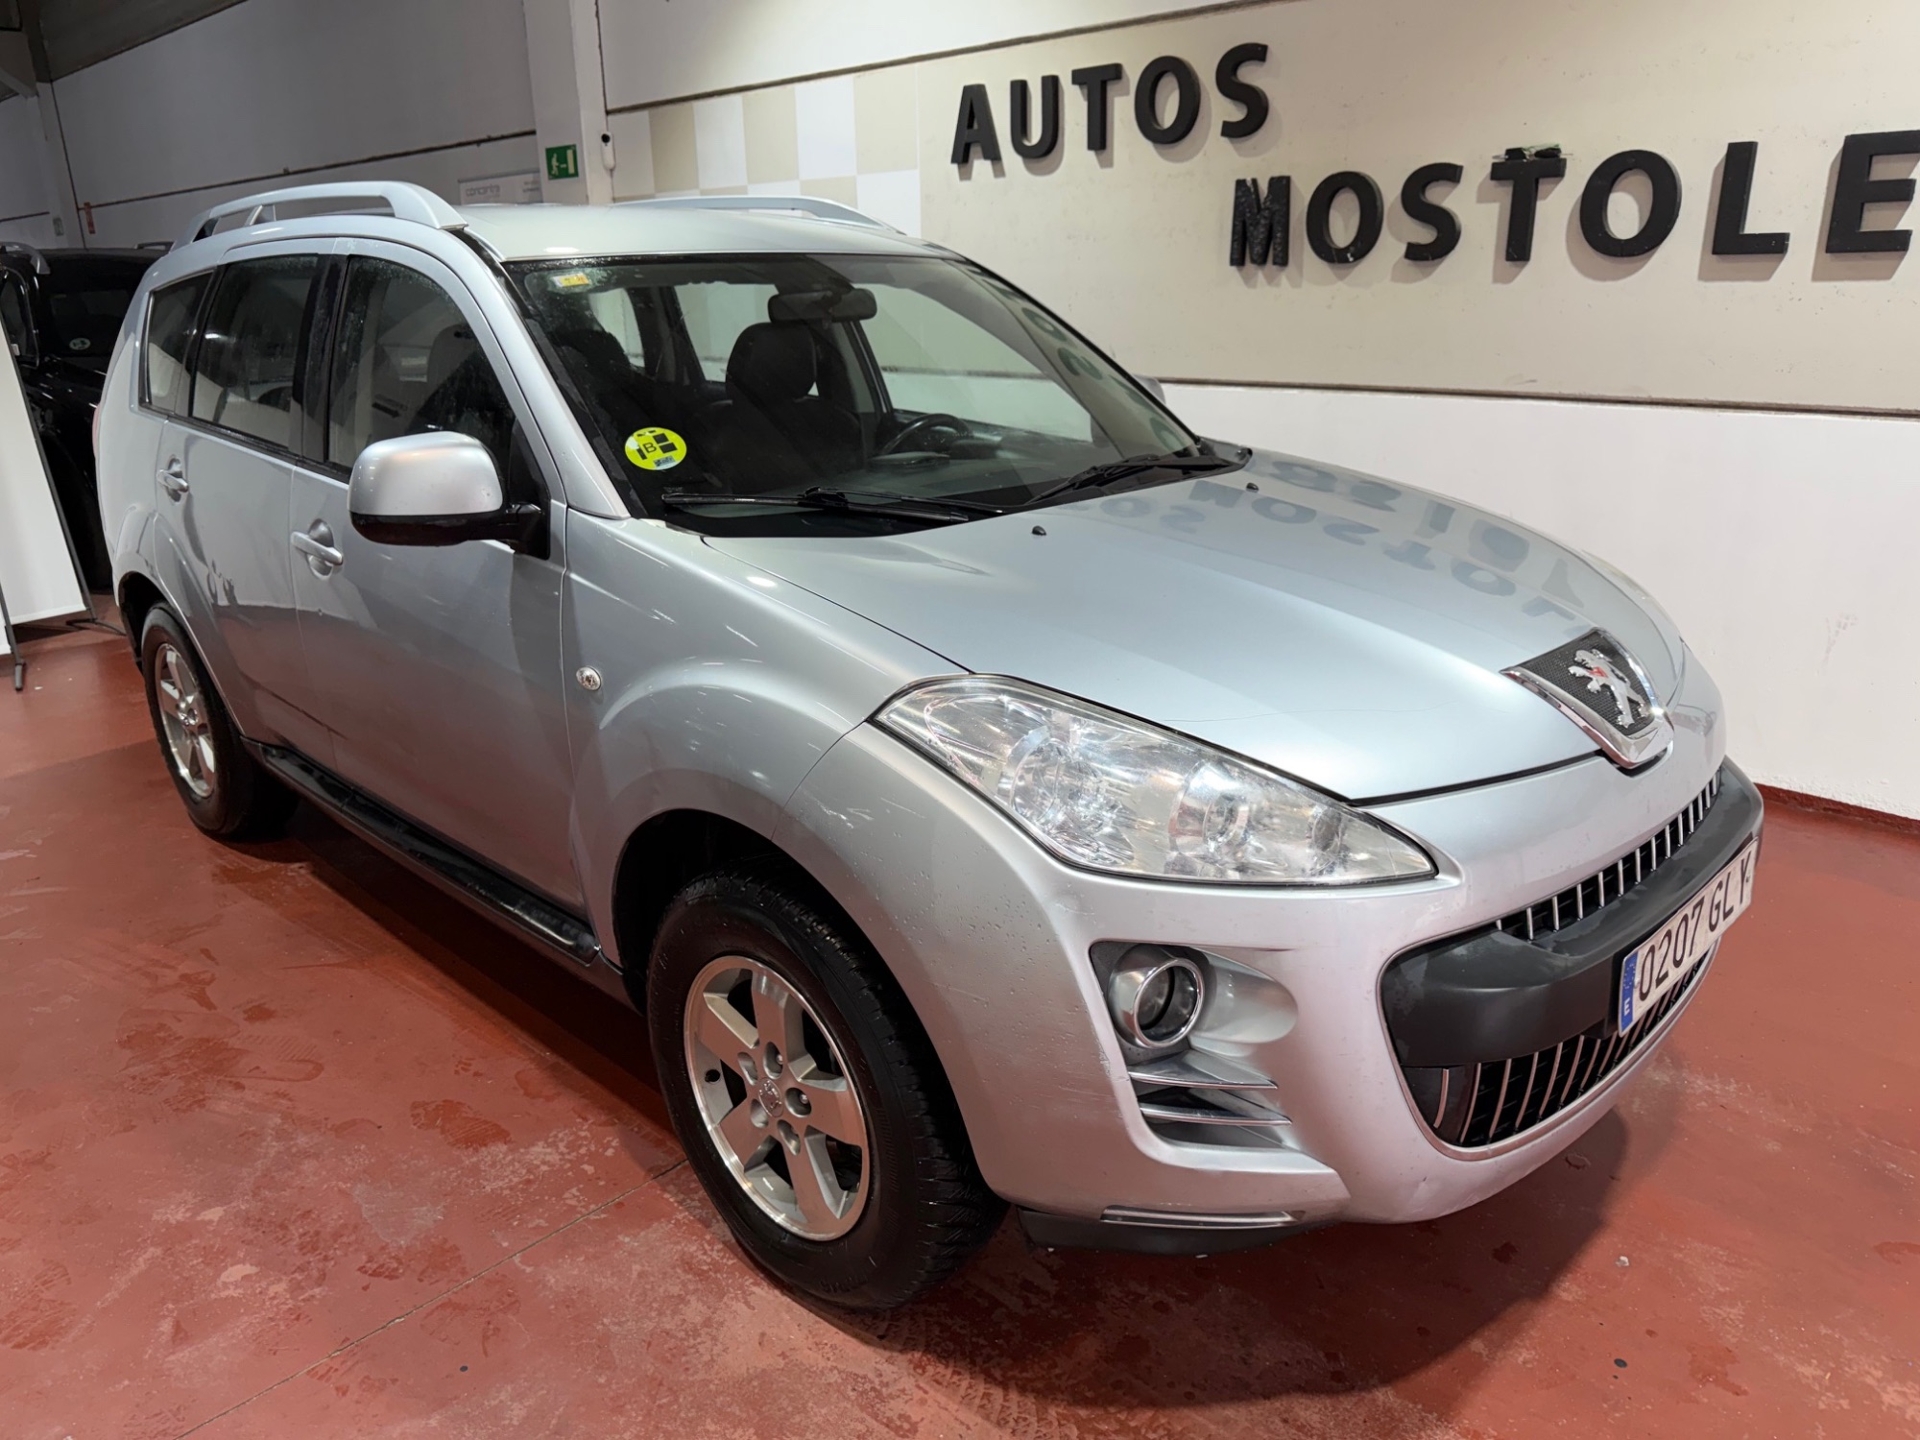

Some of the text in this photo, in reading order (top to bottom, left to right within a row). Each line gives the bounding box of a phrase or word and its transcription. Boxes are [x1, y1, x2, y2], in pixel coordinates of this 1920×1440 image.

[950, 43, 1269, 166] AUTOS
[1229, 130, 1920, 268] MOSTOLE
[642, 441, 658, 454] B
[1638, 850, 1752, 1002] 0207 GLY
